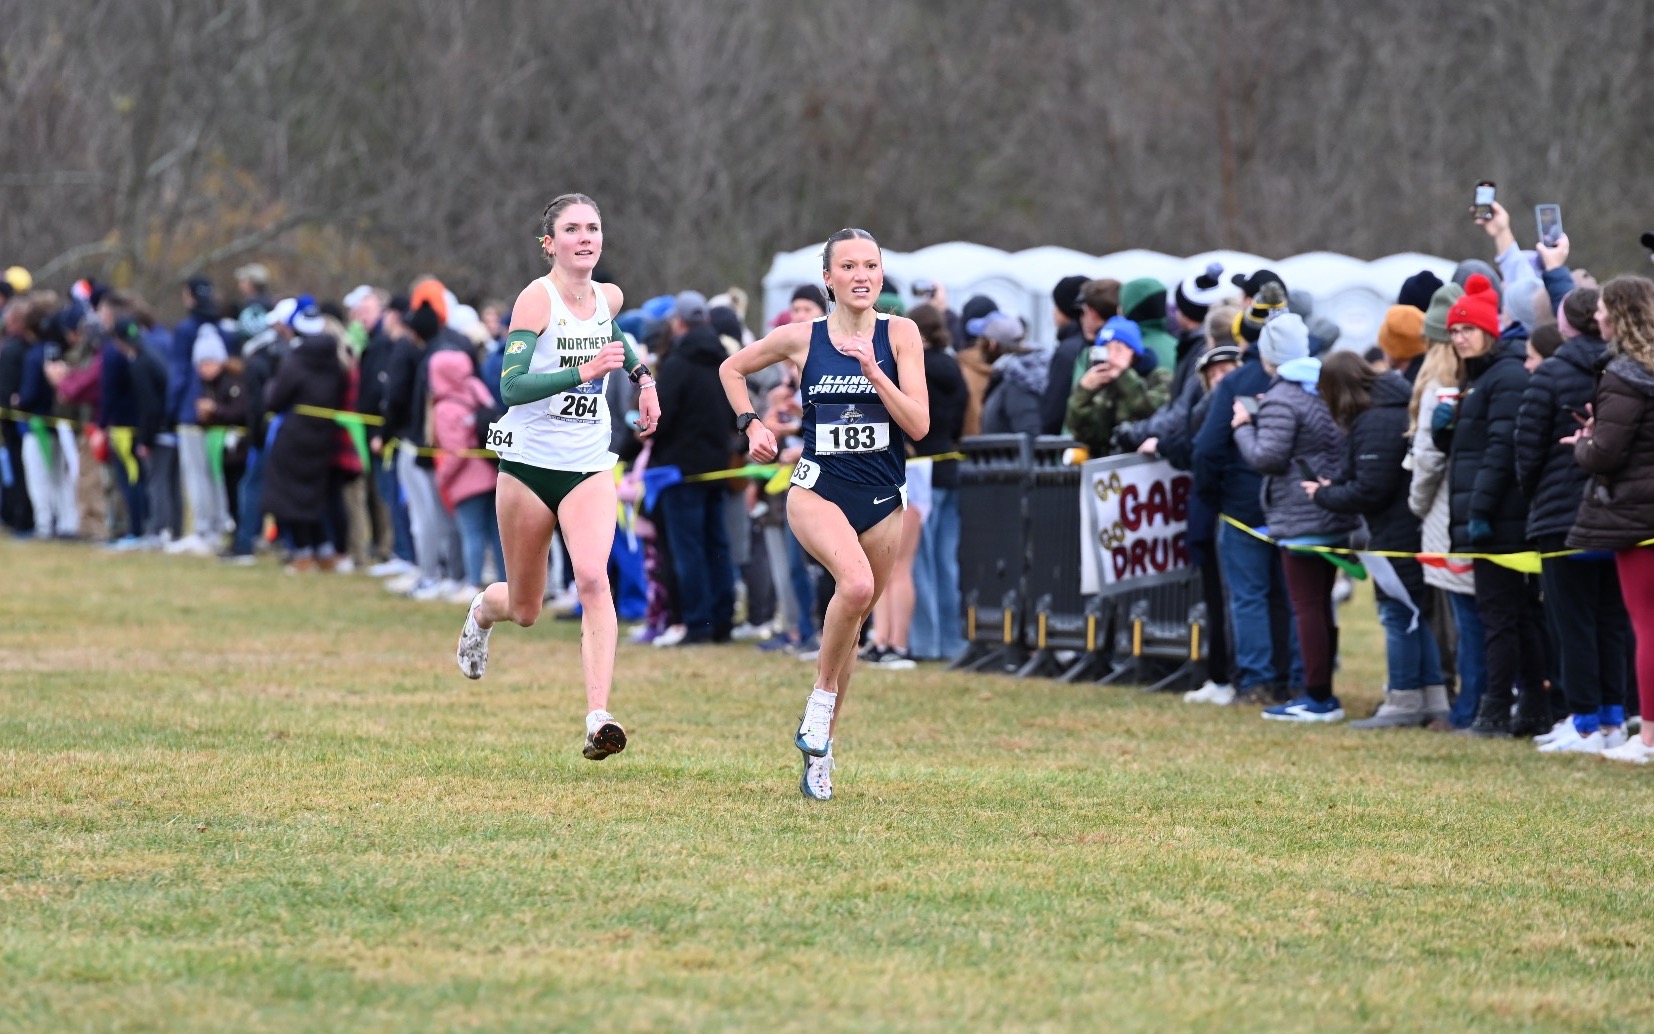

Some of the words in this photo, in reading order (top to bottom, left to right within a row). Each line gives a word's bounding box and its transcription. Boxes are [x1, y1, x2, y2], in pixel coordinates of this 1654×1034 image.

[819, 375, 872, 384] ILLINO
[560, 395, 598, 417] 264
[486, 429, 513, 448] 264
[829, 426, 876, 450] 183
[1095, 472, 1122, 502] GO
